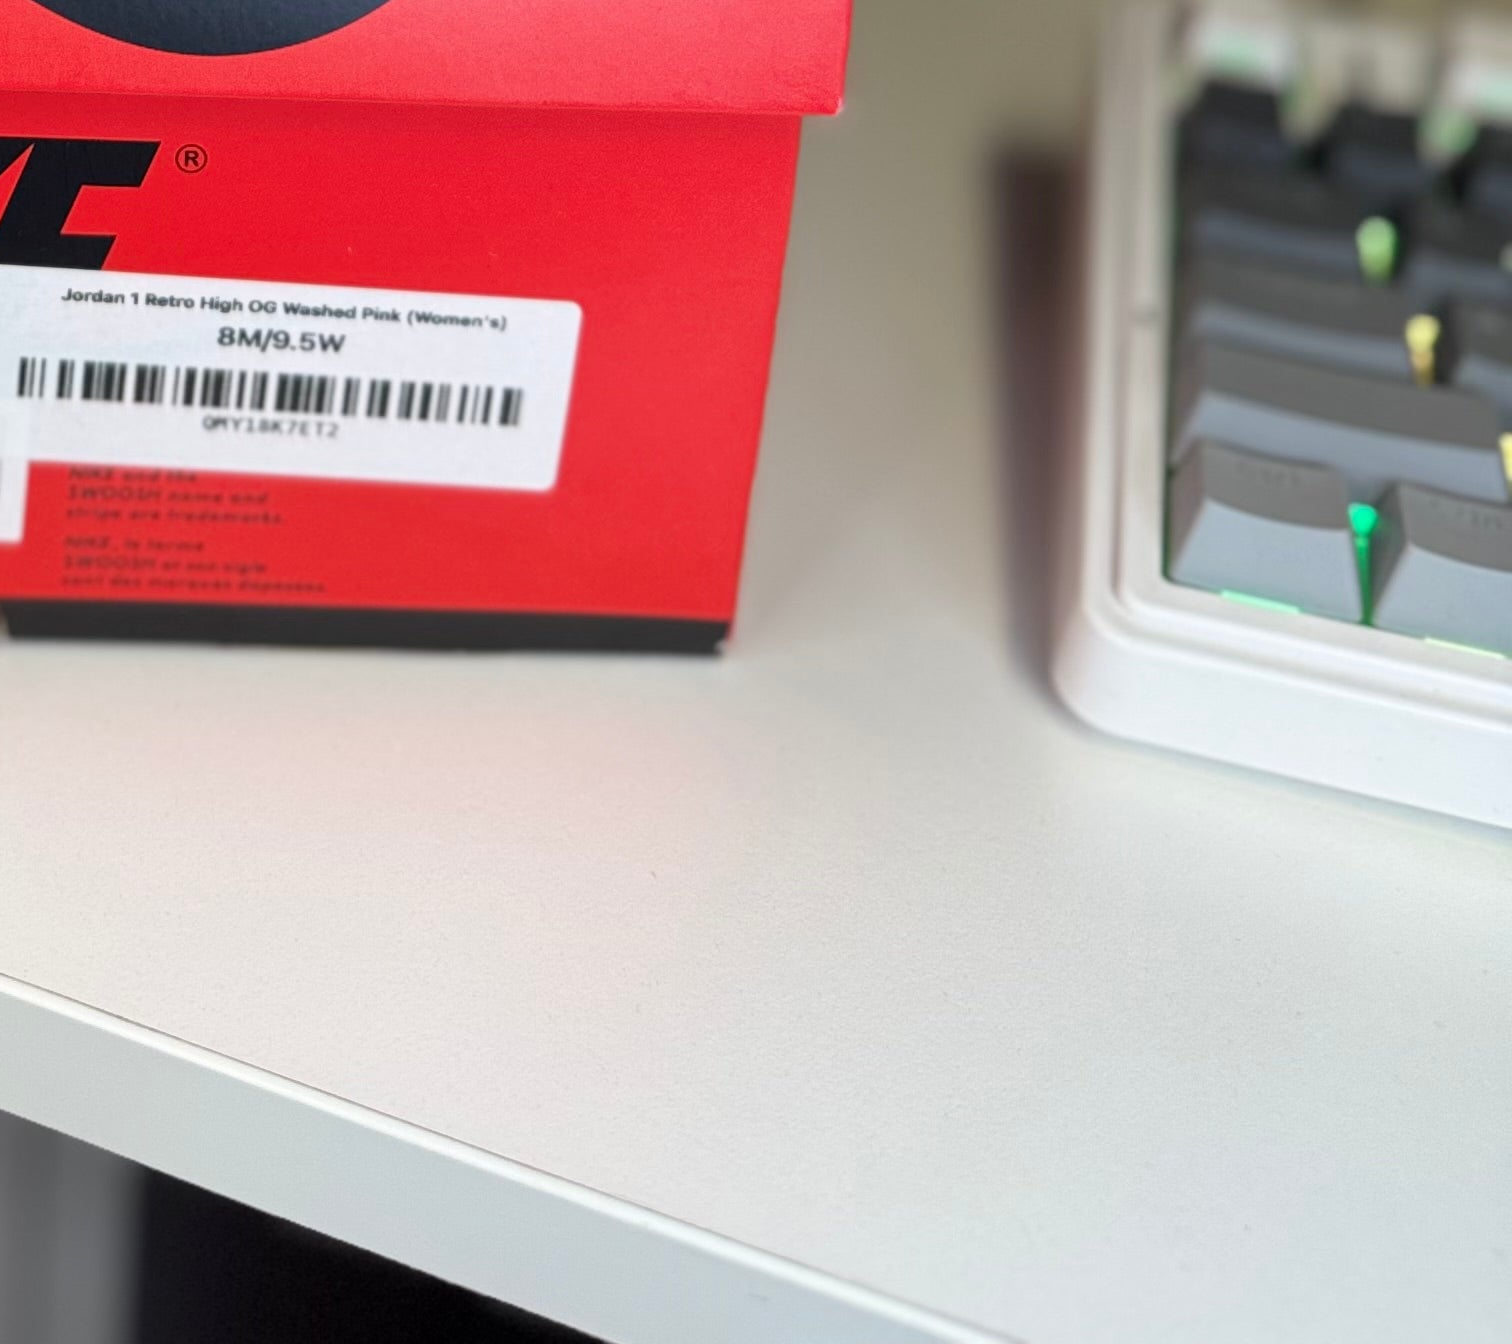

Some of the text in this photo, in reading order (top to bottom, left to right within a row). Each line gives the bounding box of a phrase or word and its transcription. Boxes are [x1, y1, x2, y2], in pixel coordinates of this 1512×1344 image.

[61, 288, 507, 332] Jordan 1 Retro High OG Washed Pink (Women's)
[217, 326, 346, 353] 8M/9.5W
[202, 415, 339, 438] QMY18K7ET2
